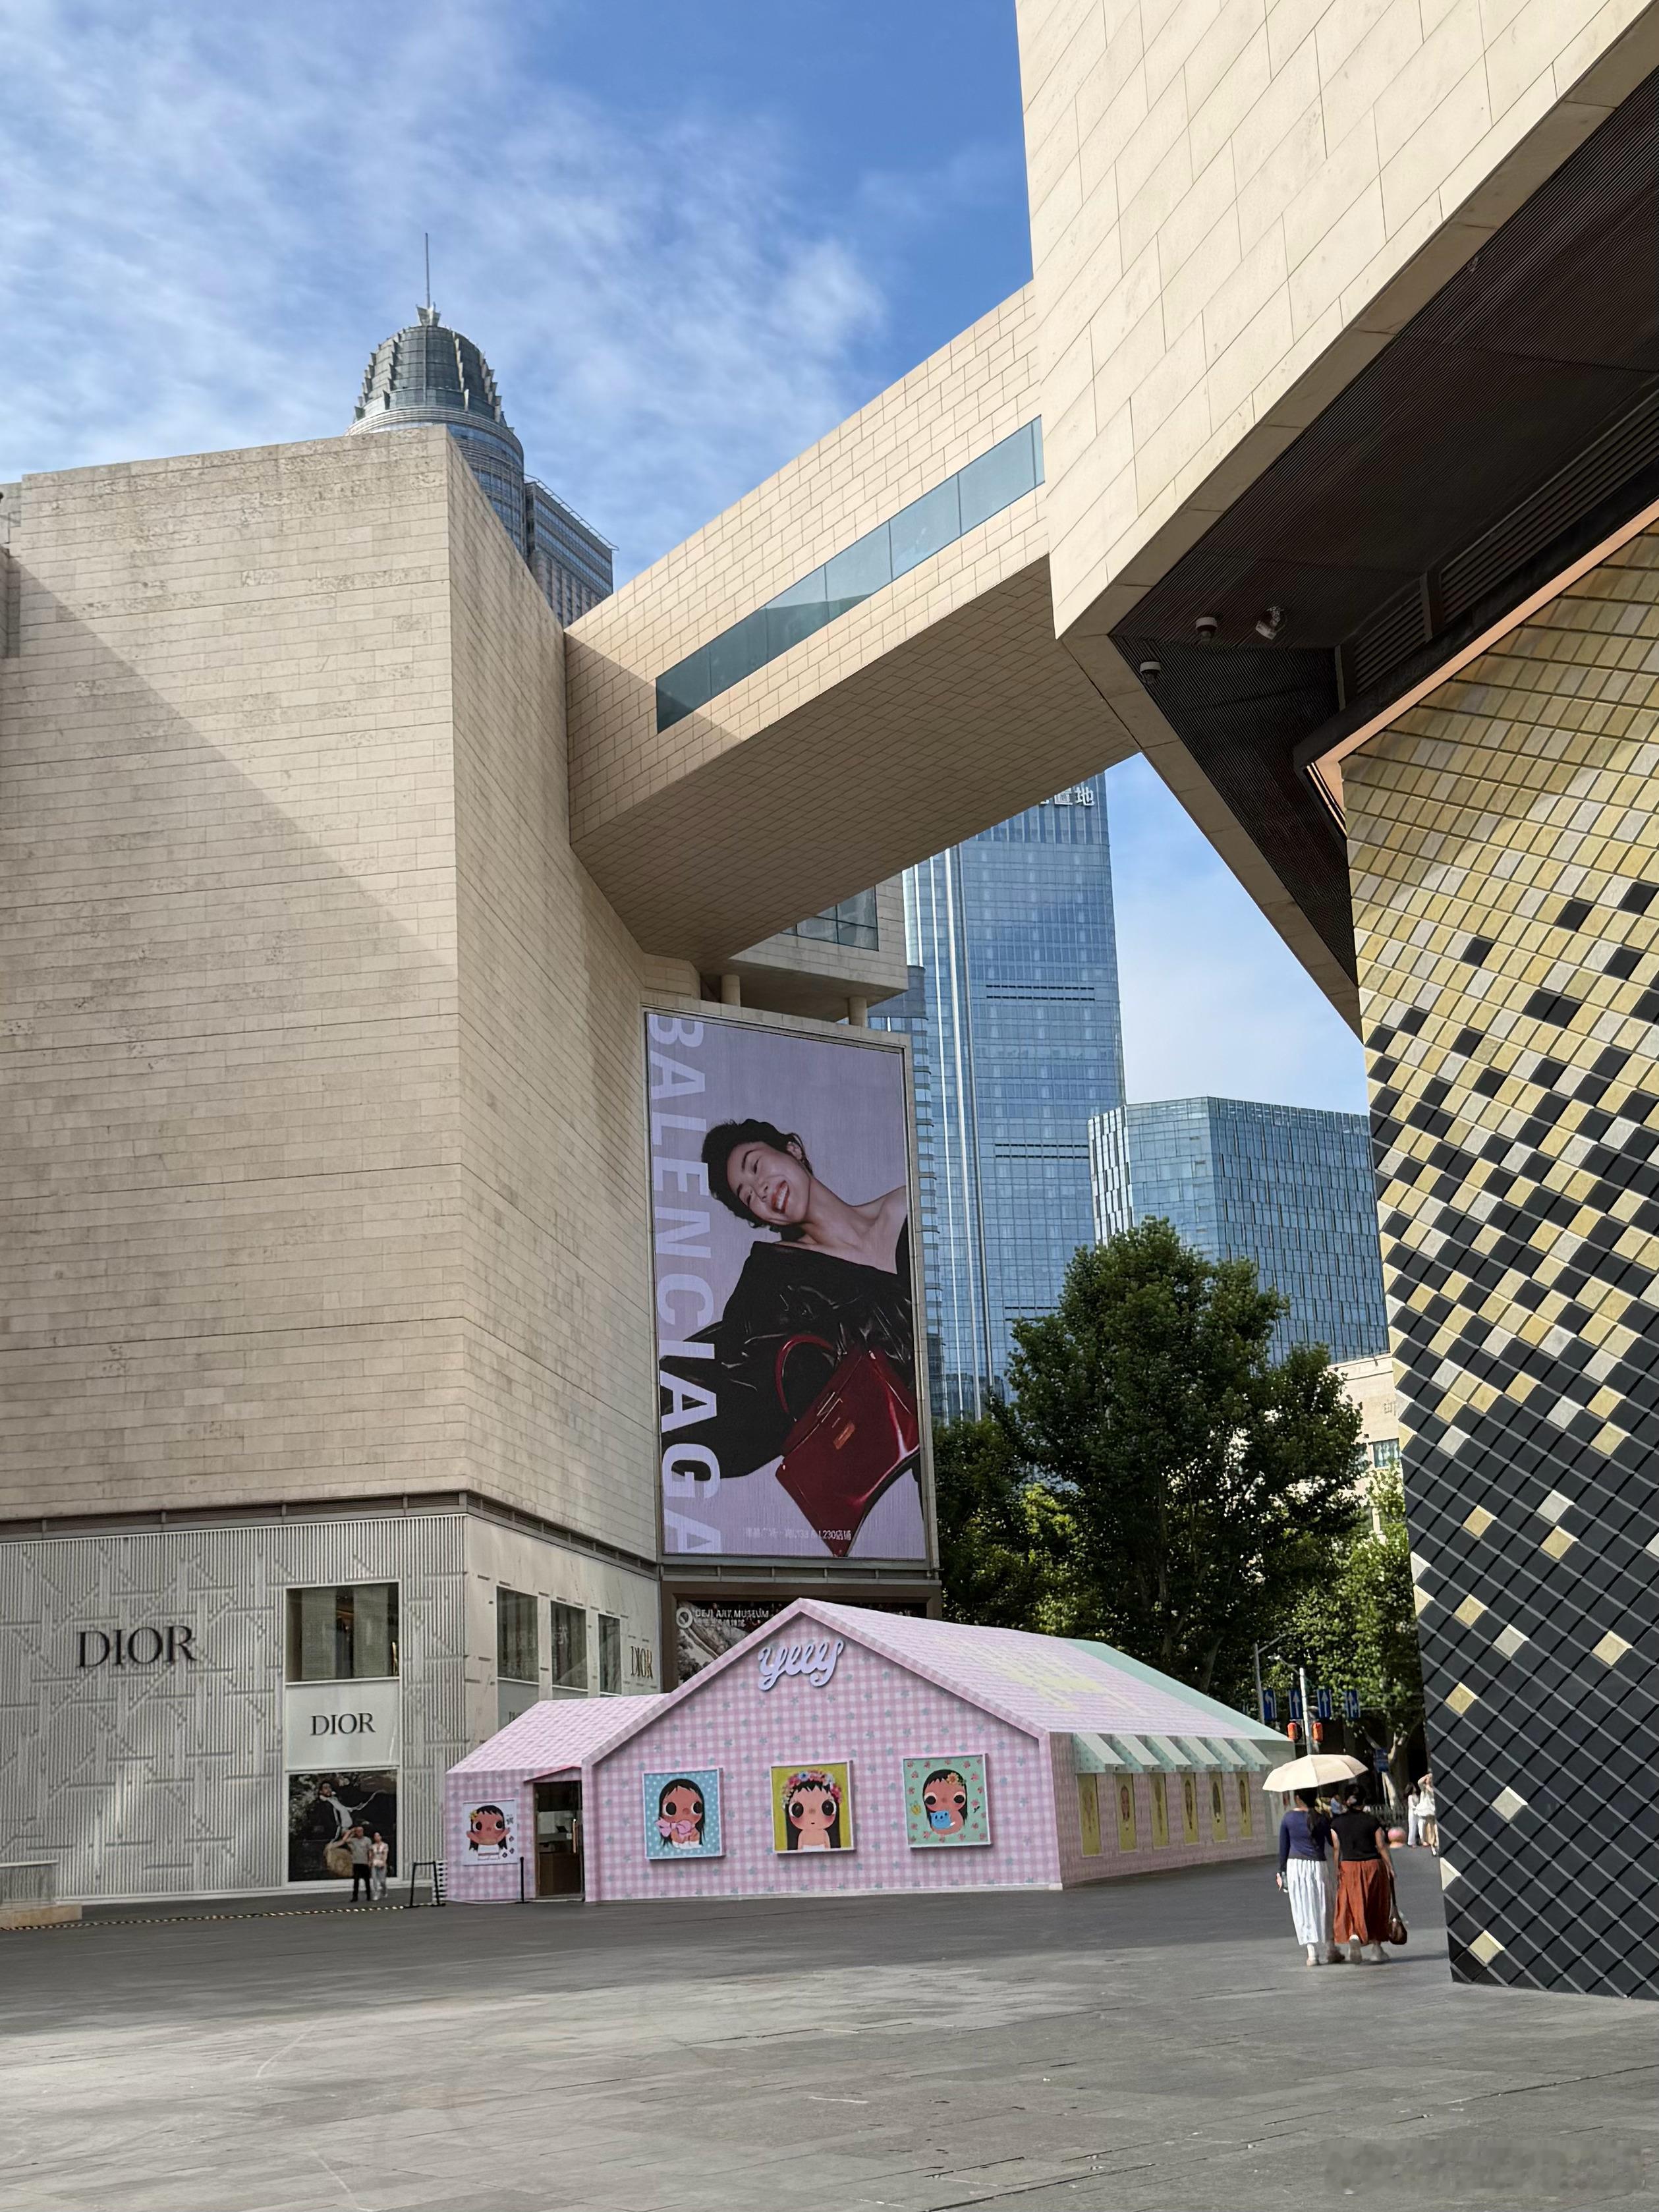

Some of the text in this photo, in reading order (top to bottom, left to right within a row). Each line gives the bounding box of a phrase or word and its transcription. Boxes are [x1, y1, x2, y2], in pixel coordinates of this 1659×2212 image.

[648, 1014, 723, 1554] BALENCIAGA
[733, 1608, 769, 1618] MUSEUM
[76, 1625, 198, 1668] DIOR
[631, 1646, 653, 1679] DIOR
[310, 1713, 376, 1736] DIOR
